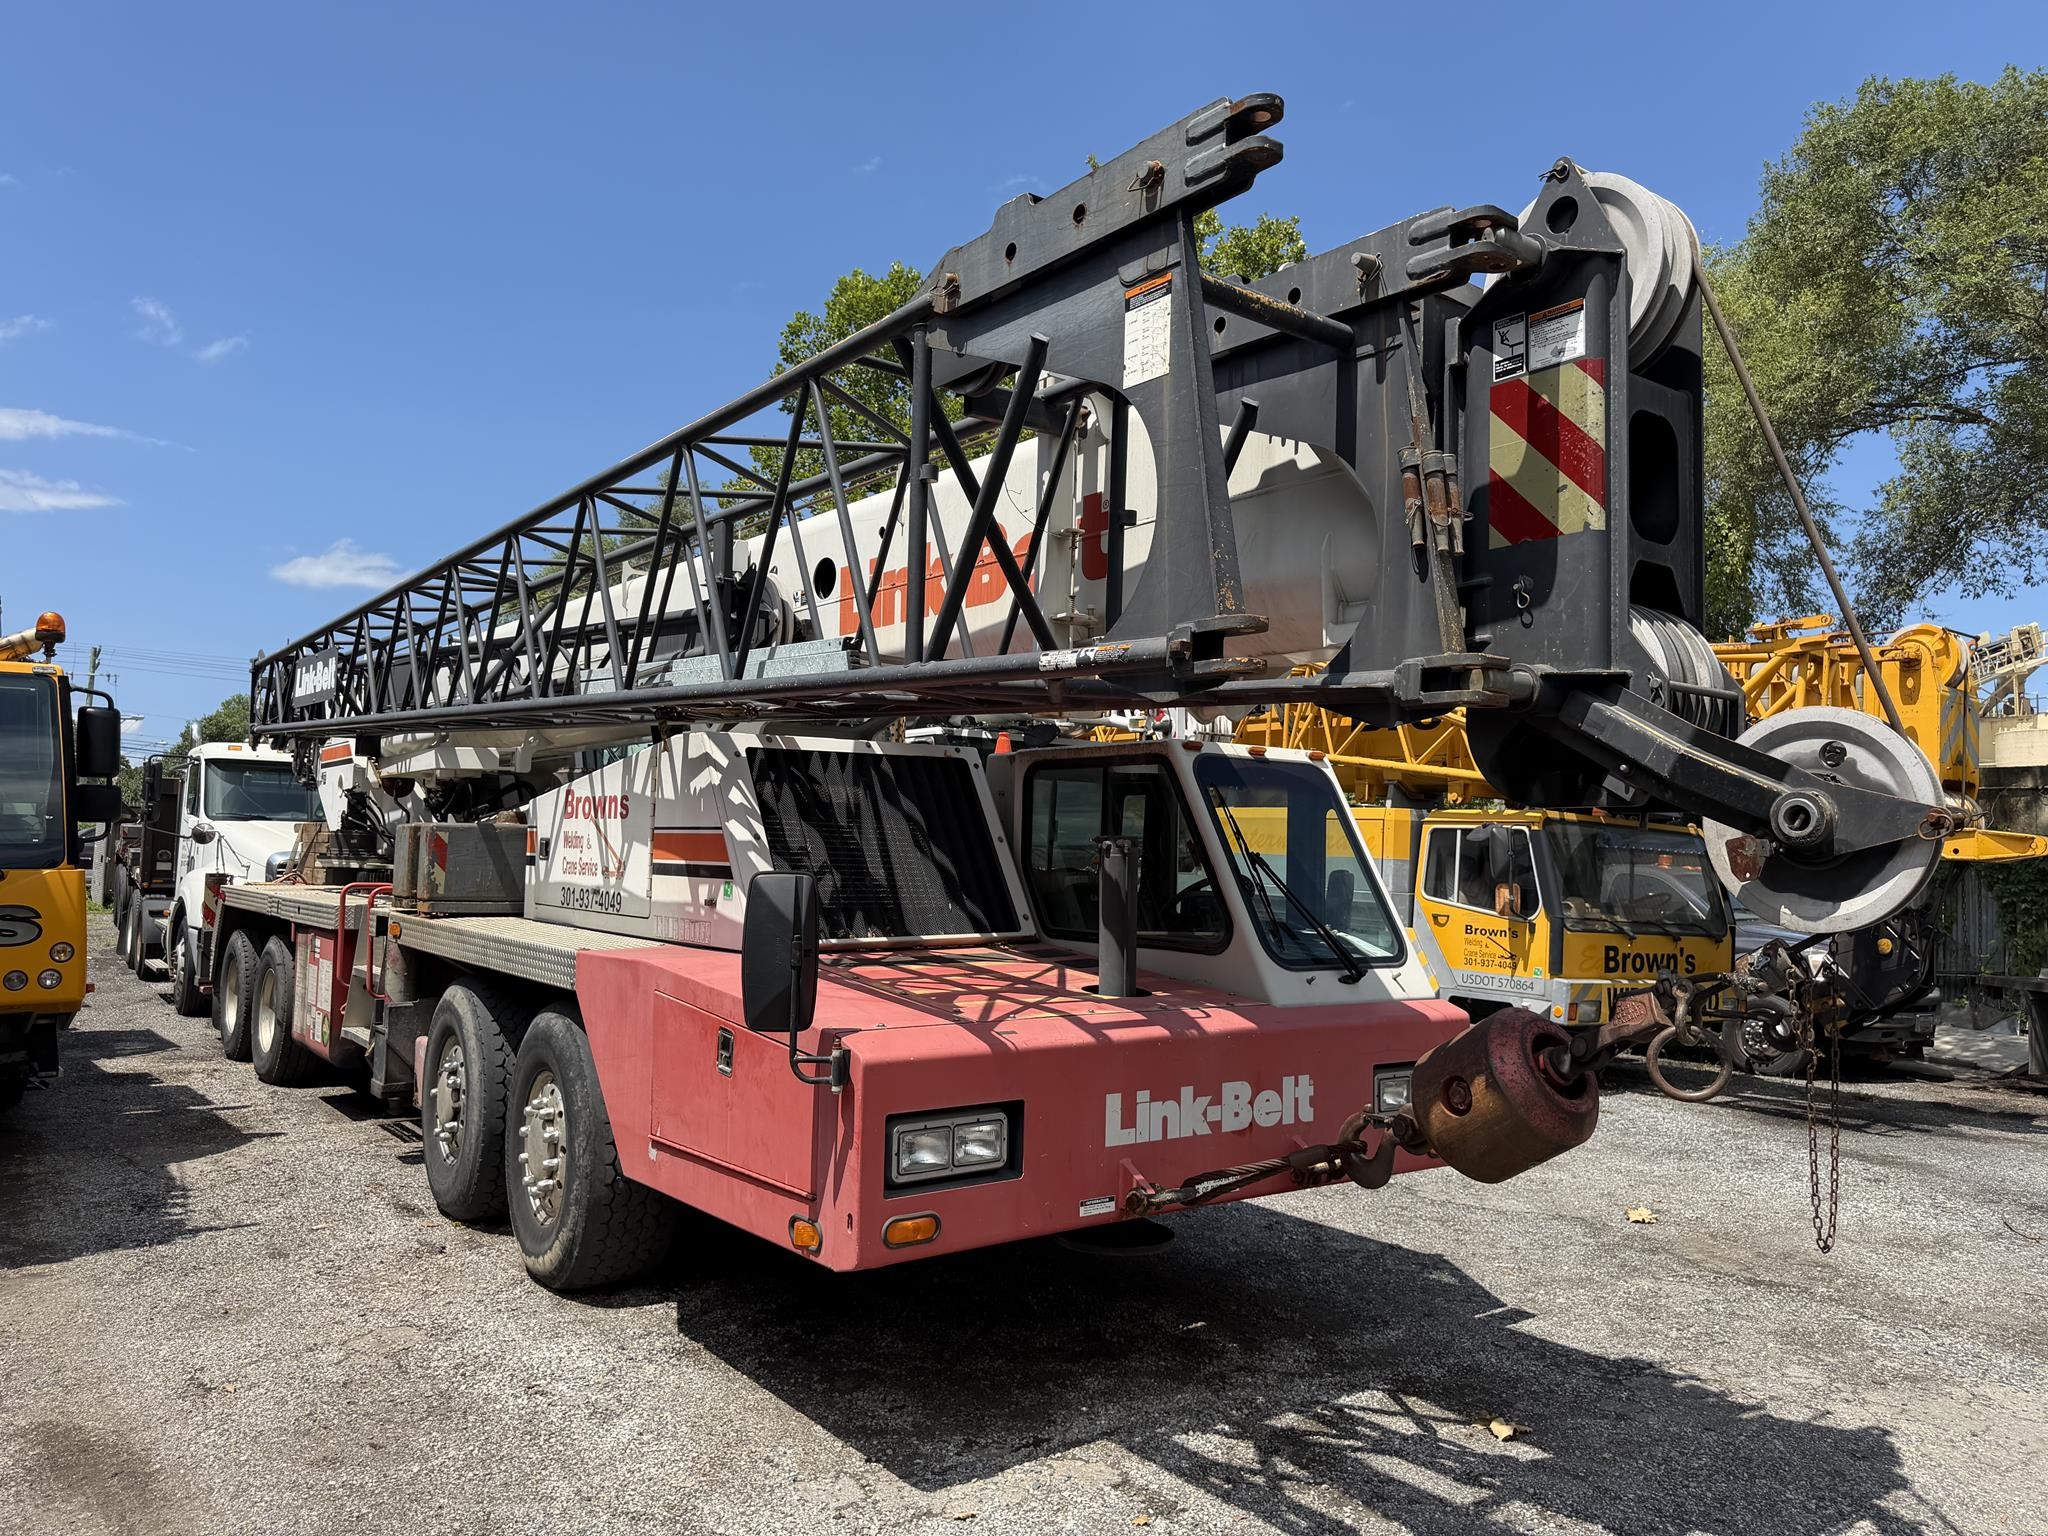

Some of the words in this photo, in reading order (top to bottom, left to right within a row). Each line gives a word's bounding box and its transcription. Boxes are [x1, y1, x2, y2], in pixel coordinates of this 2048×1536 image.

[295, 656, 337, 698] Link-Belt
[563, 788, 630, 820] Browns
[563, 830, 584, 854] Welding
[562, 856, 578, 876] Crane
[579, 856, 598, 877] Service
[560, 886, 622, 913] 301-937-4049
[1464, 924, 1519, 939] Brown's
[1463, 948, 1478, 958] Crane
[1478, 949, 1497, 959] Service
[1463, 957, 1518, 970] 301-937-4049
[1604, 945, 1697, 974] Brown's
[1461, 973, 1496, 987] USDOT
[1497, 977, 1535, 992] 570864
[1105, 1073, 1315, 1148] Link-Belt
